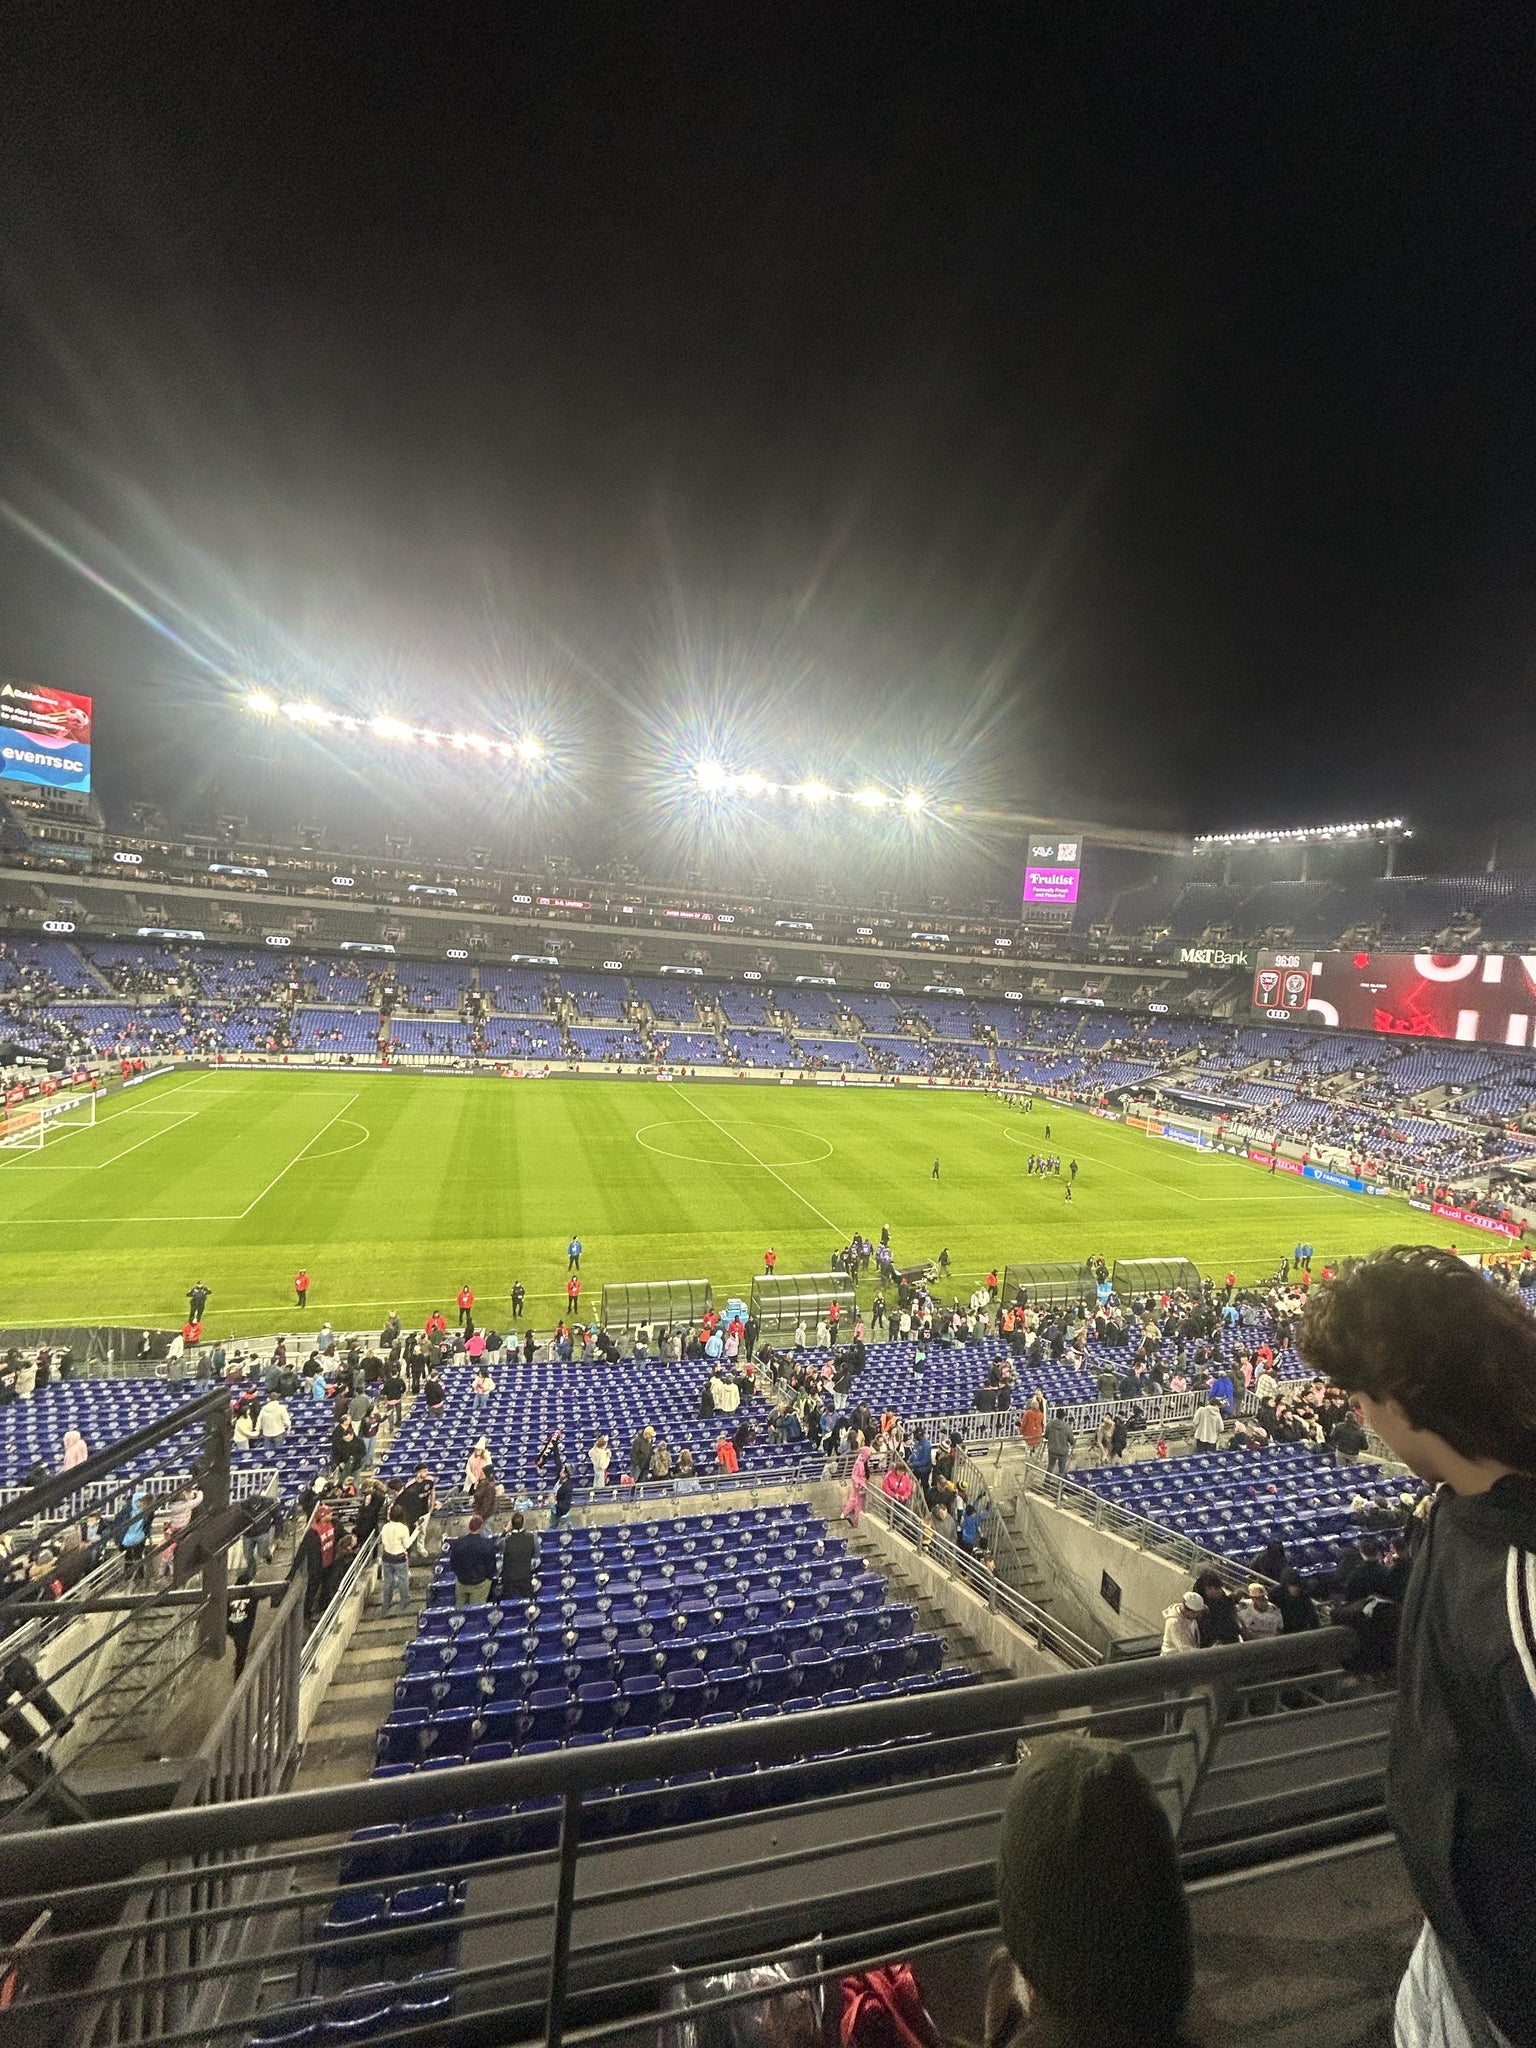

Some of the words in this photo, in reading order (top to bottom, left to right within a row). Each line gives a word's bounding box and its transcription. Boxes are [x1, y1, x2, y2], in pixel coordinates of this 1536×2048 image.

[1029, 873, 1074, 885] Fruitist
[1180, 948, 1215, 963] M&T
[1214, 950, 1248, 965] Bank
[1275, 955, 1300, 967] 96:06
[1263, 993, 1268, 1004] 1
[1289, 994, 1298, 1006] 2
[1253, 1153, 1269, 1164] Audi
[1322, 1174, 1350, 1187] FANDUEL
[1437, 1206, 1462, 1219] Audi
